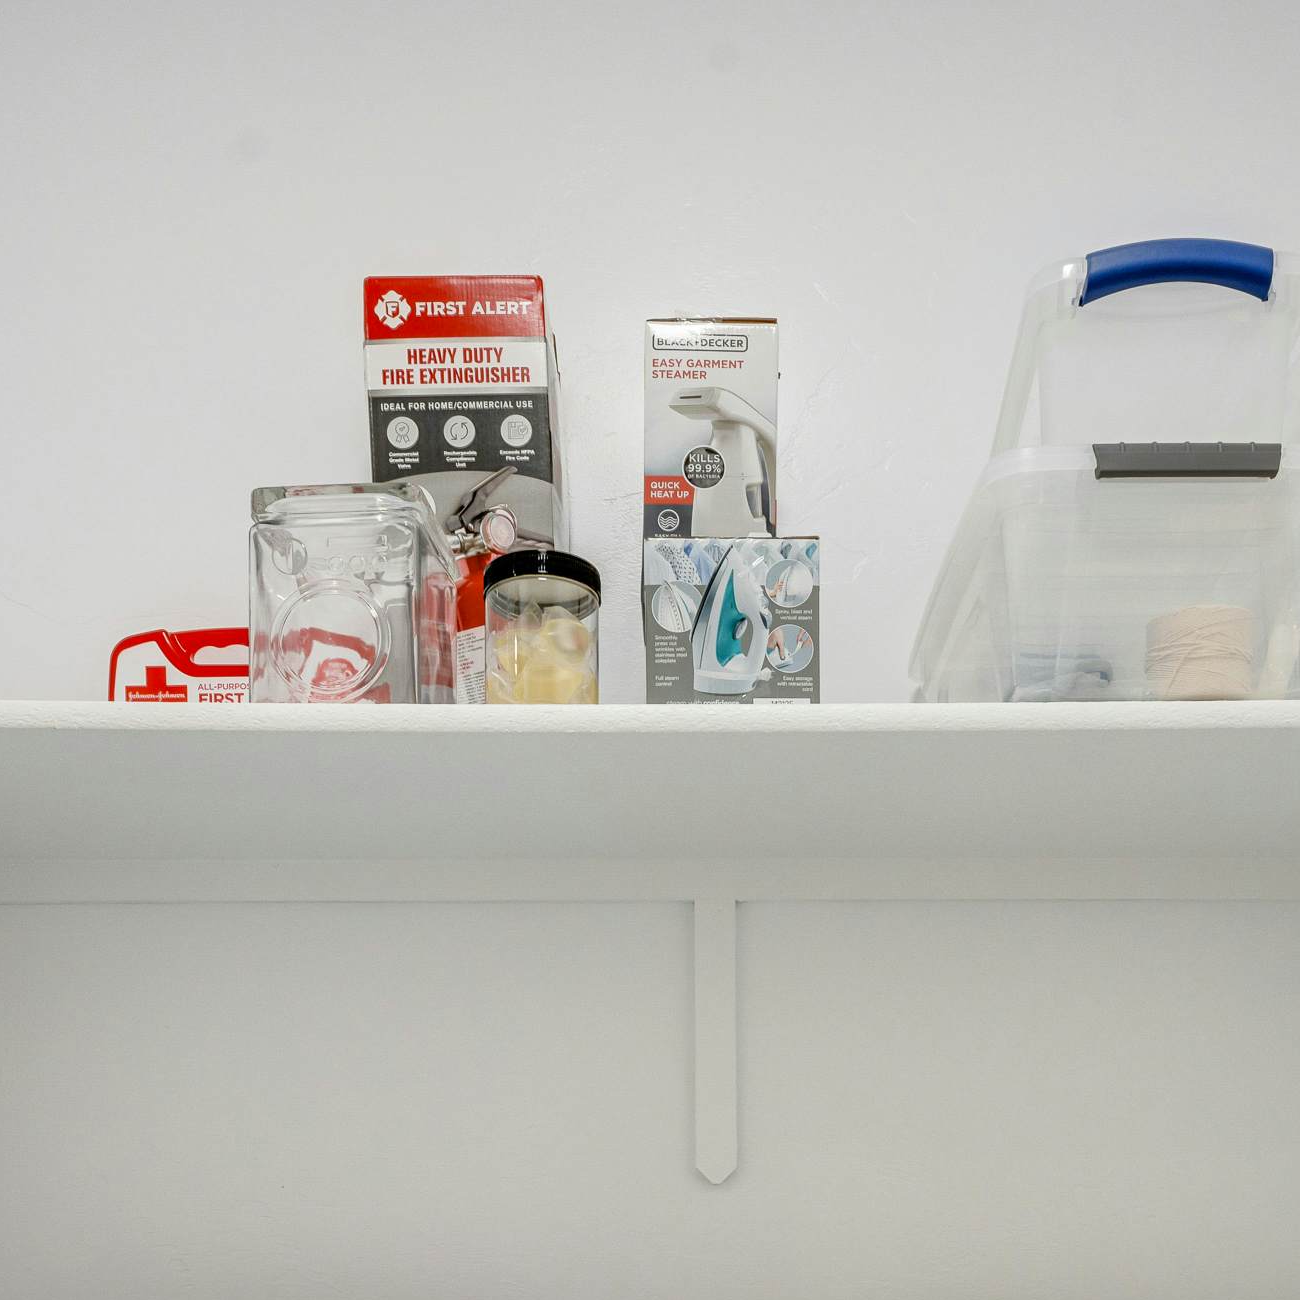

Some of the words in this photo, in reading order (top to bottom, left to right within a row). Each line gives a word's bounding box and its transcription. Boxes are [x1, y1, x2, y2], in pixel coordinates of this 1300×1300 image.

[415, 302, 466, 316] FIRST
[472, 302, 532, 315] ALERT
[407, 348, 456, 364] HEAVY
[463, 348, 503, 363] DUTY
[652, 359, 683, 368] EASY
[687, 360, 744, 368] GARMENT
[382, 369, 414, 385] FIRE
[420, 367, 530, 384] EXTINGUISHER
[652, 370, 707, 379] STEAMER
[381, 403, 405, 411] IDEAL
[408, 402, 426, 410] FOR
[428, 401, 513, 410] HOME/COMMERCIAL
[690, 454, 720, 462] KILLS
[688, 464, 721, 472] 99.9%
[199, 693, 244, 703] FIRST
